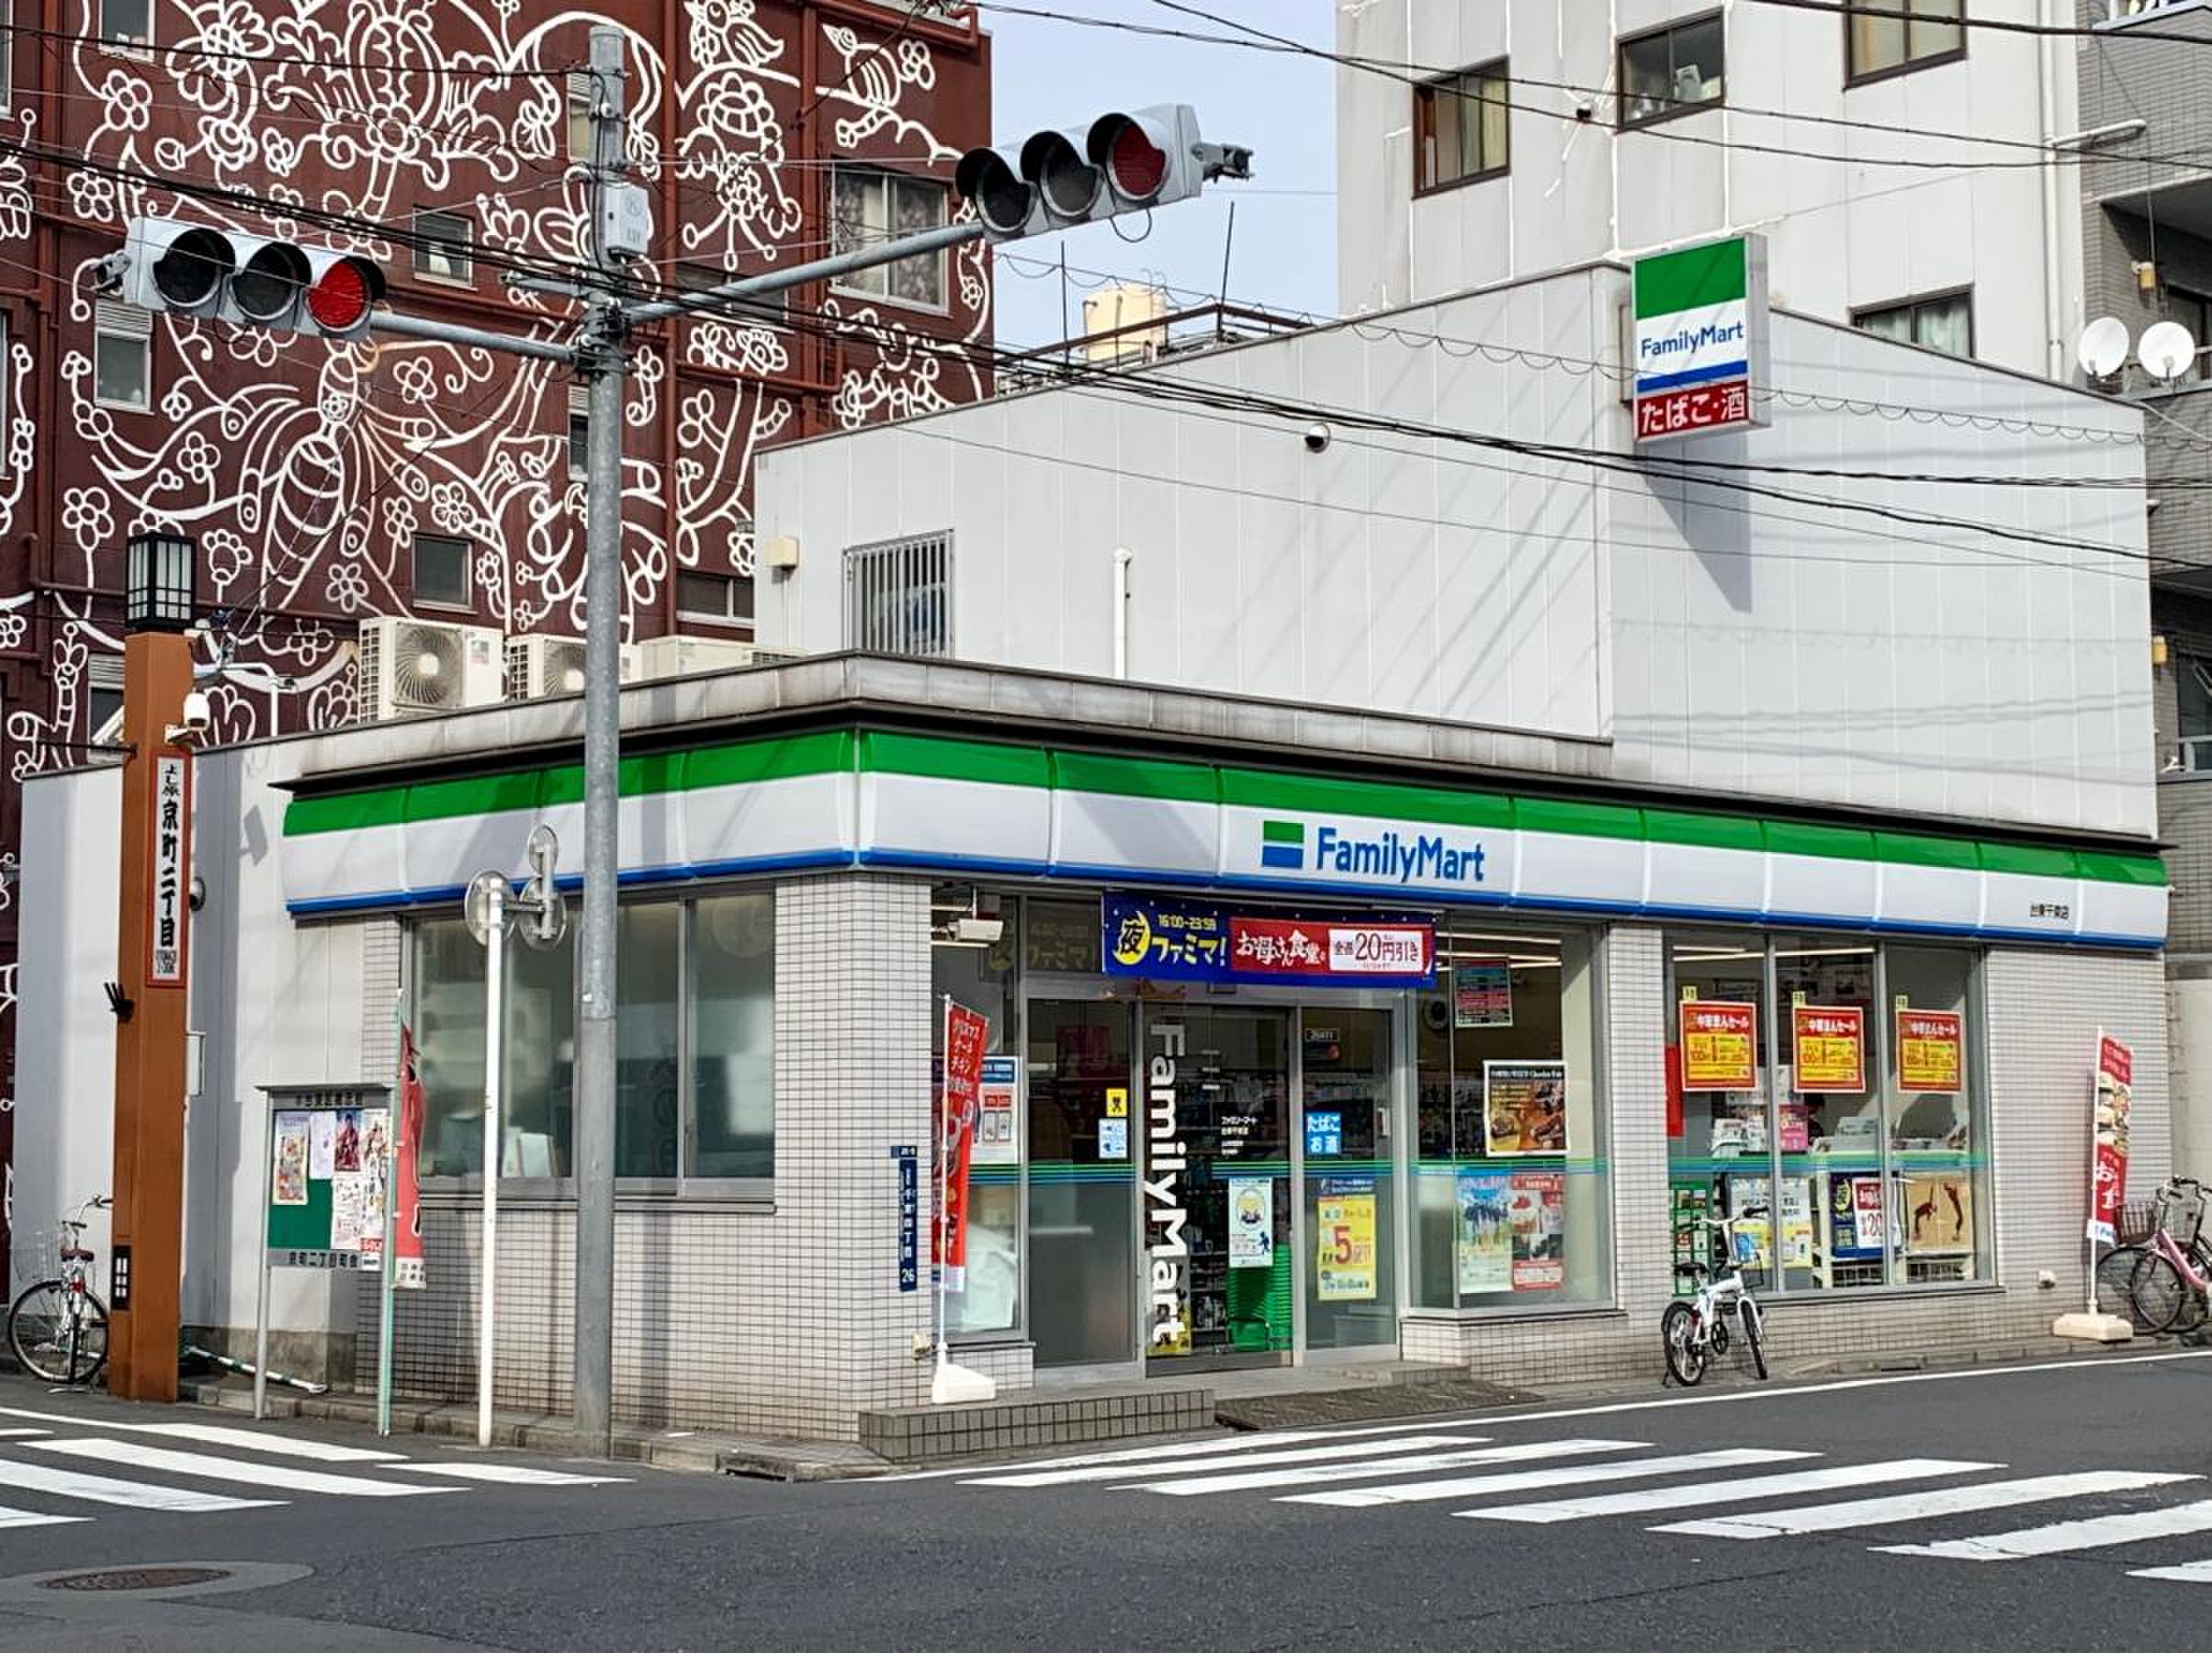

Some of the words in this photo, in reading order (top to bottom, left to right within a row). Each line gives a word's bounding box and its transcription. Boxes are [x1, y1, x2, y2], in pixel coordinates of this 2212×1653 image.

[1641, 320, 1744, 358] FamilyMart
[161, 798, 178, 948] 京町二丁目
[1316, 826, 1484, 883] FamilyMart
[1144, 1024, 1187, 1344] FamilyMart
